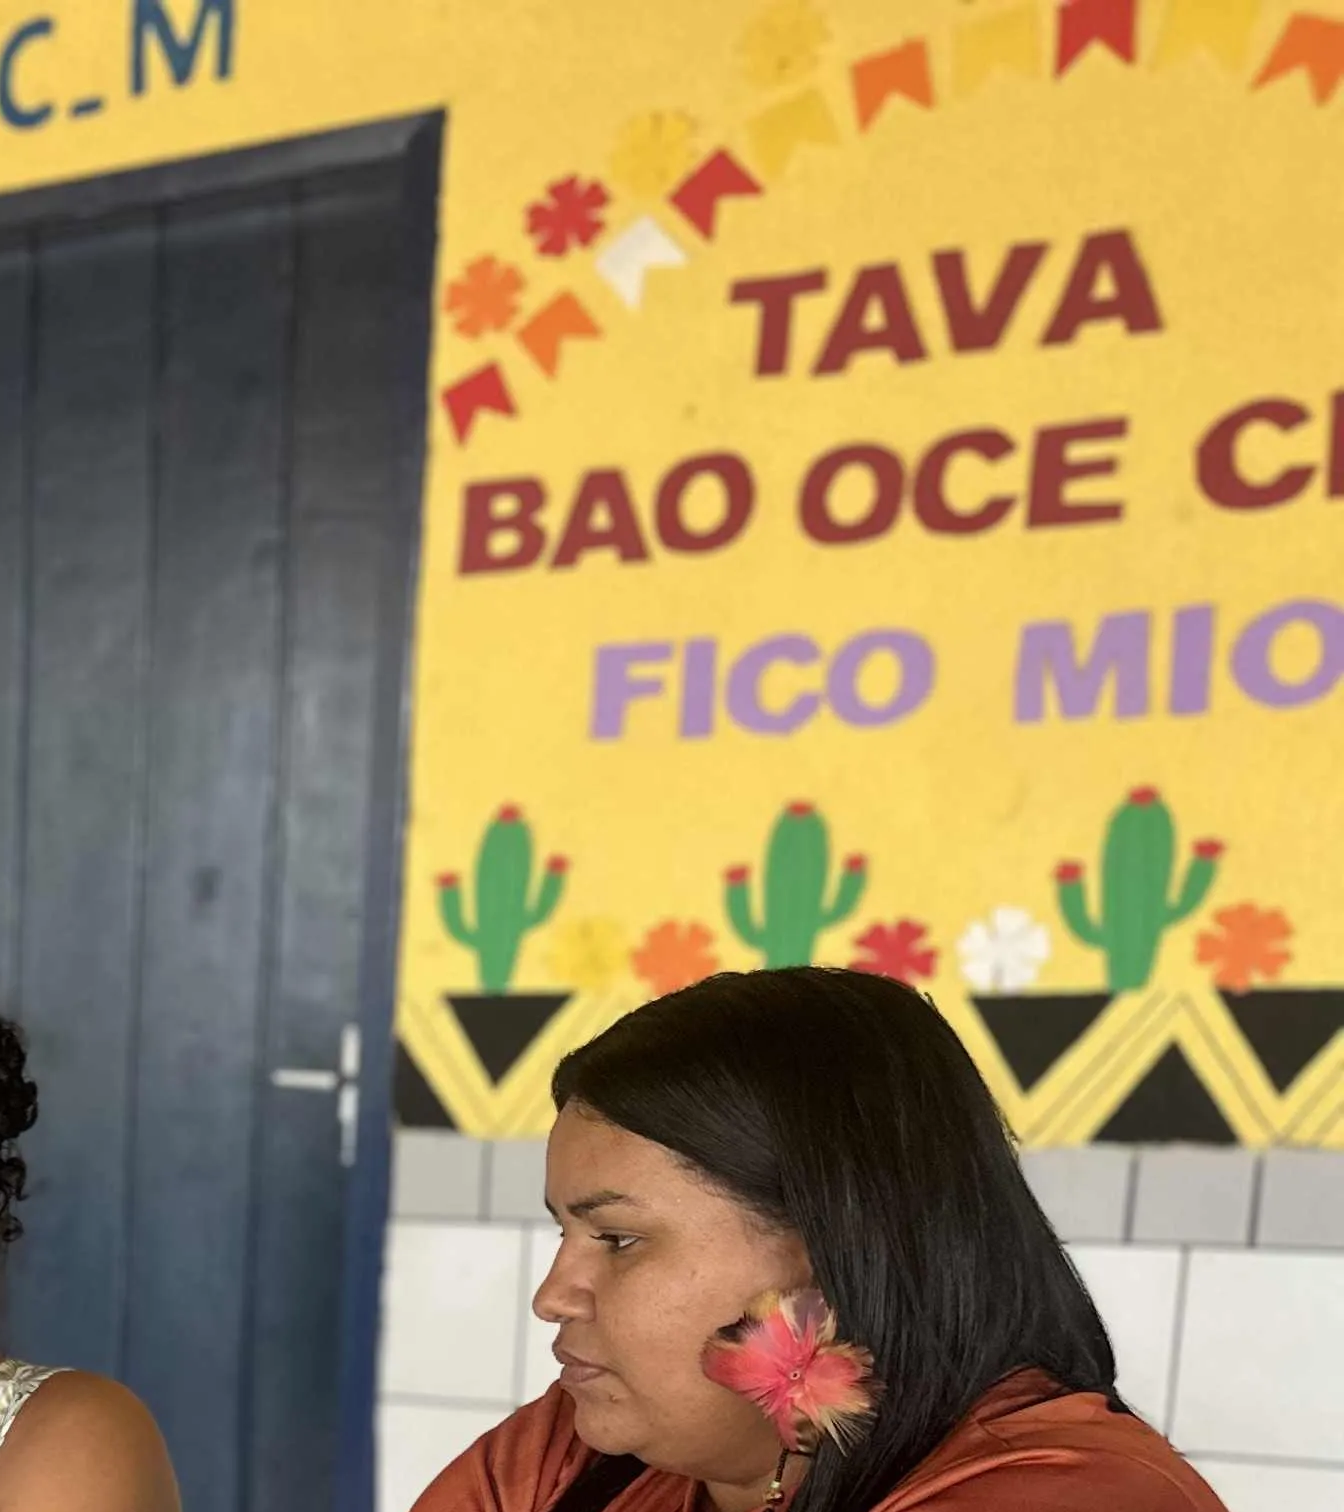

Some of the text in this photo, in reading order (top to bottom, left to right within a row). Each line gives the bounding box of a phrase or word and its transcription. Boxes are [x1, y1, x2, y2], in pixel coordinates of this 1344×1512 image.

[729, 229, 1164, 378] TAVA
[457, 452, 756, 576] BAO
[798, 417, 1128, 546] OCE
[588, 598, 1344, 740] FICO MIO
